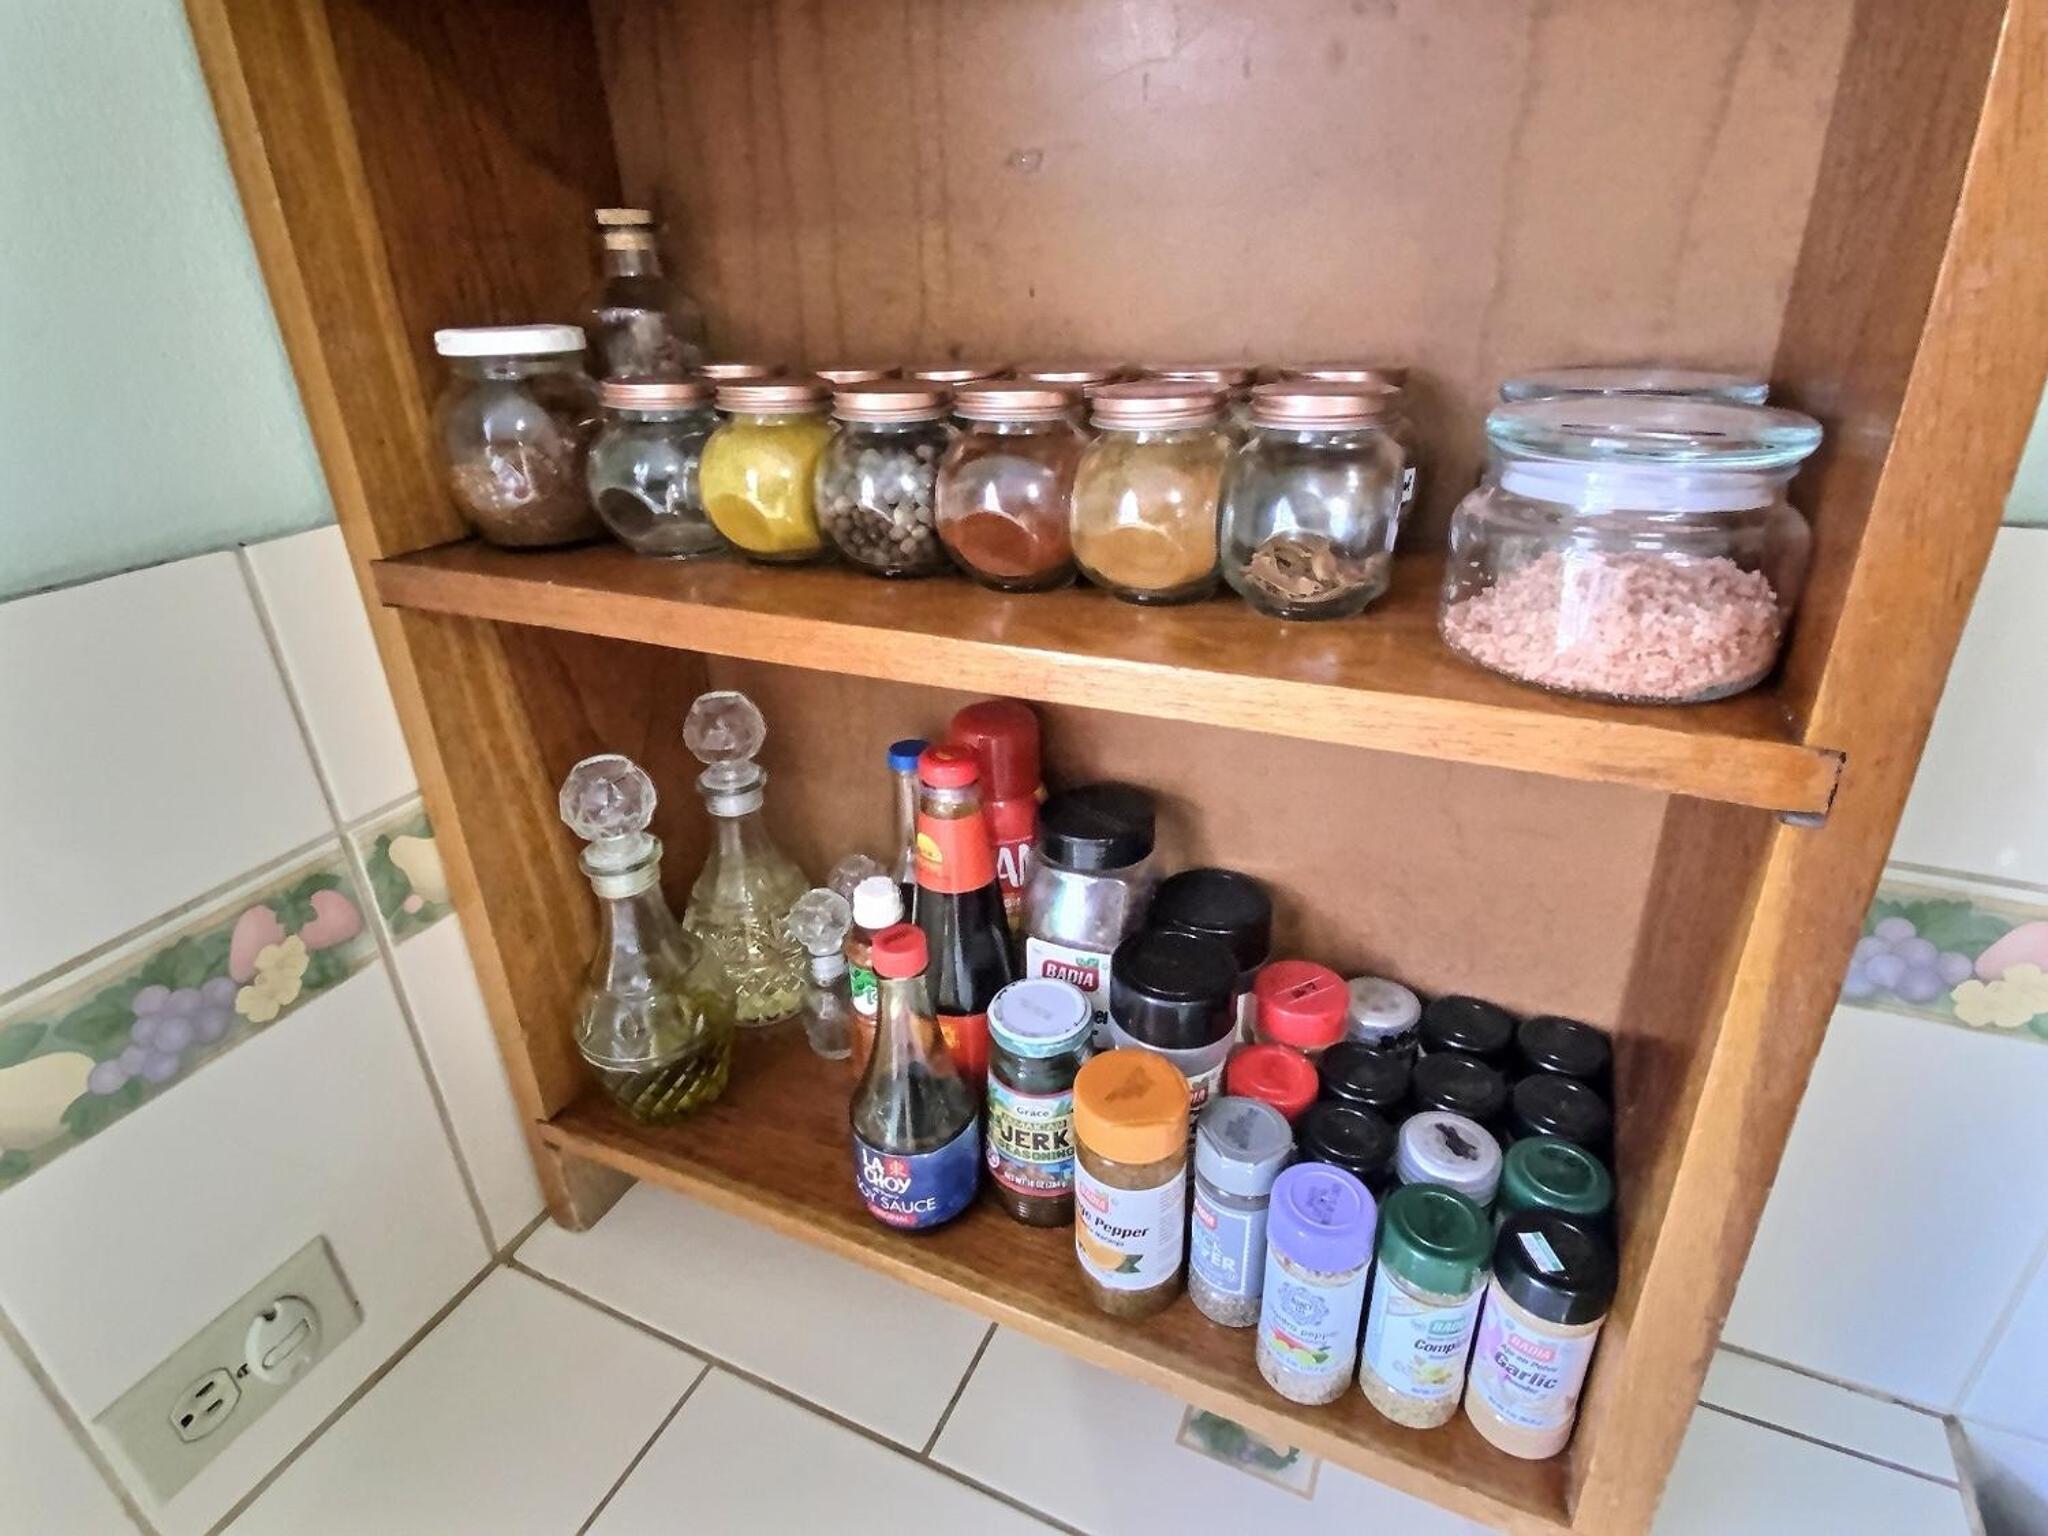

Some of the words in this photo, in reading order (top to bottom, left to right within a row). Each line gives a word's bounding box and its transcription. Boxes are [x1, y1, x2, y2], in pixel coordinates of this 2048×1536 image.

[1046, 963, 1094, 987] BADIA
[1017, 1106, 1050, 1117] Grace
[1001, 1124, 1070, 1151] JERK
[862, 1147, 885, 1174] LA
[863, 1165, 912, 1194] CHOY
[880, 1197, 937, 1214] SAUCE
[1094, 1216, 1150, 1239] Pepper
[1495, 1351, 1558, 1389] Garlic
